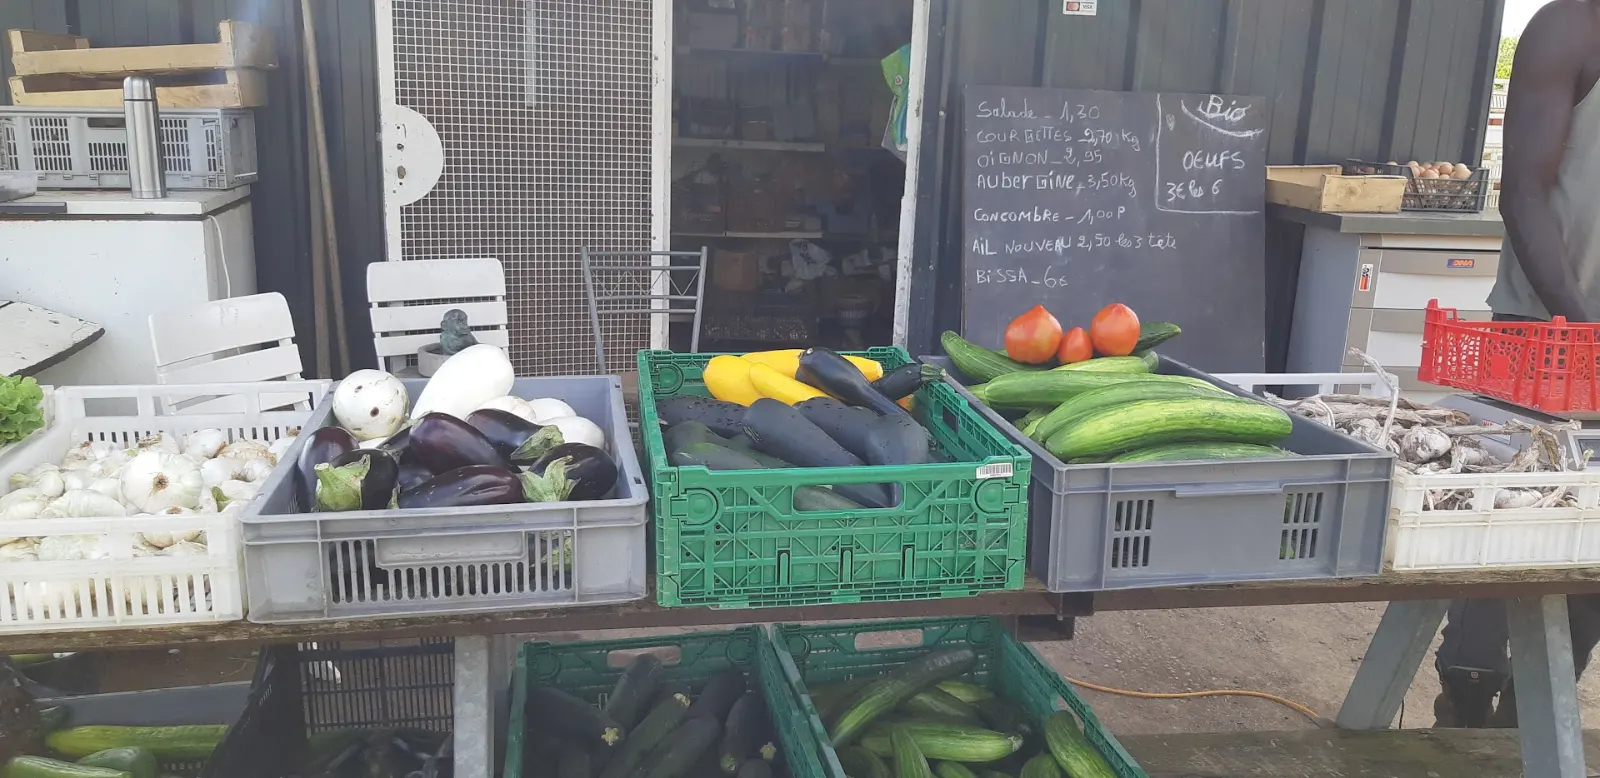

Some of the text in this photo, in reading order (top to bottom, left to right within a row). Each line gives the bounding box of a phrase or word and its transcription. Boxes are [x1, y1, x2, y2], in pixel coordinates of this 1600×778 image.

[976, 97, 1037, 119] Salade
[1060, 101, 1100, 123] 1,30
[1197, 93, 1251, 121] Bio
[1183, 149, 1246, 172] OEUFS
[1211, 179, 1223, 195] 6
